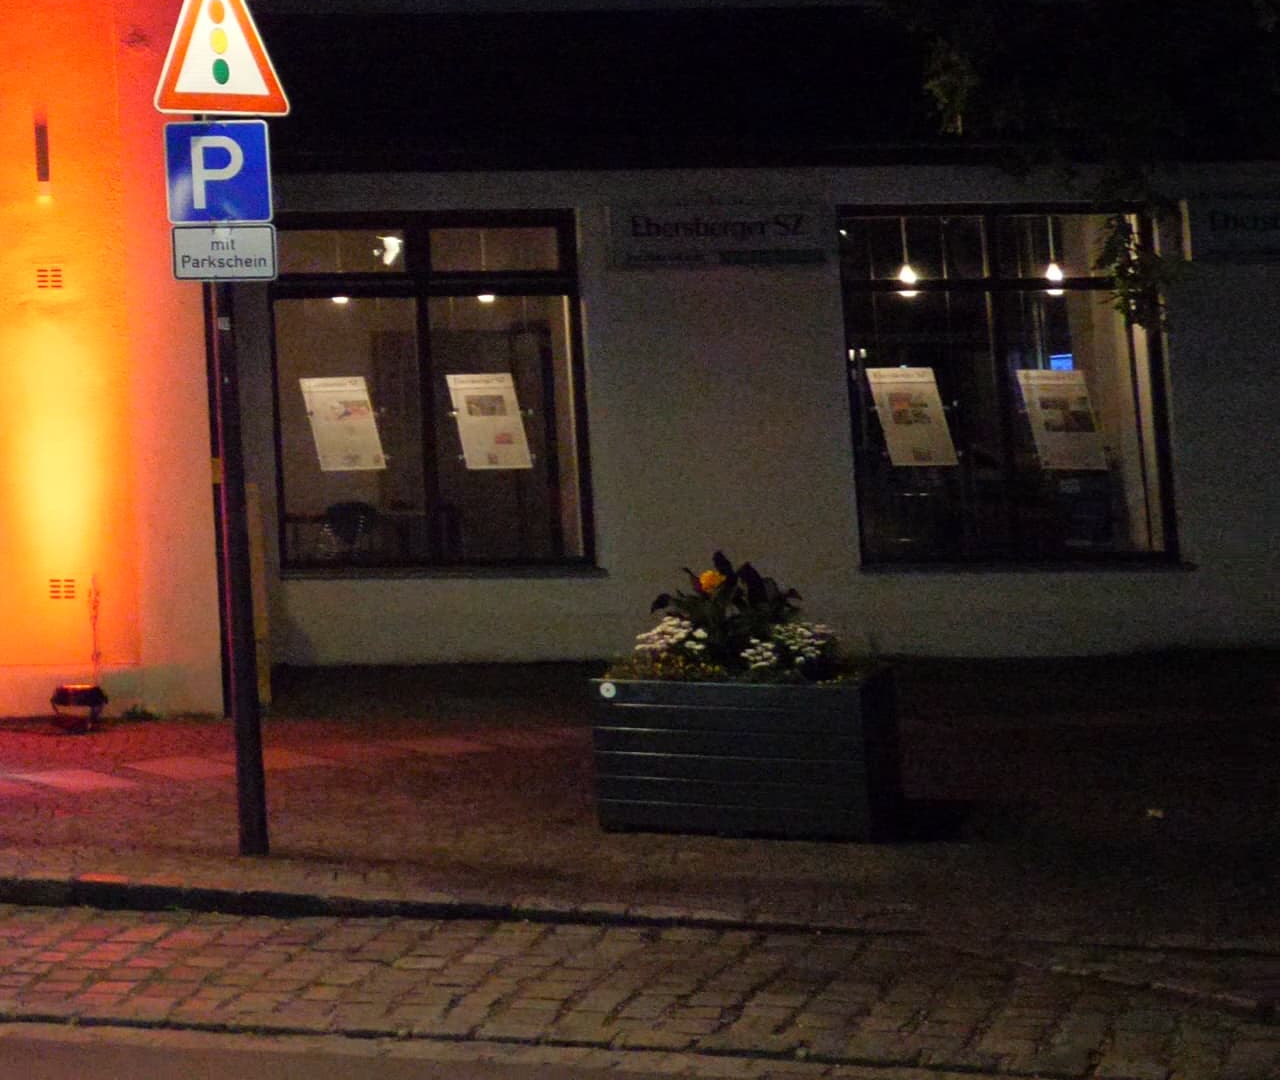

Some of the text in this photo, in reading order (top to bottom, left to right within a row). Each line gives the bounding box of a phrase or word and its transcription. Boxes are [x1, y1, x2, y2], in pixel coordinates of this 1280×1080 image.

[191, 136, 245, 210] P
[210, 239, 236, 251] mit
[181, 255, 267, 269] Parkschein
